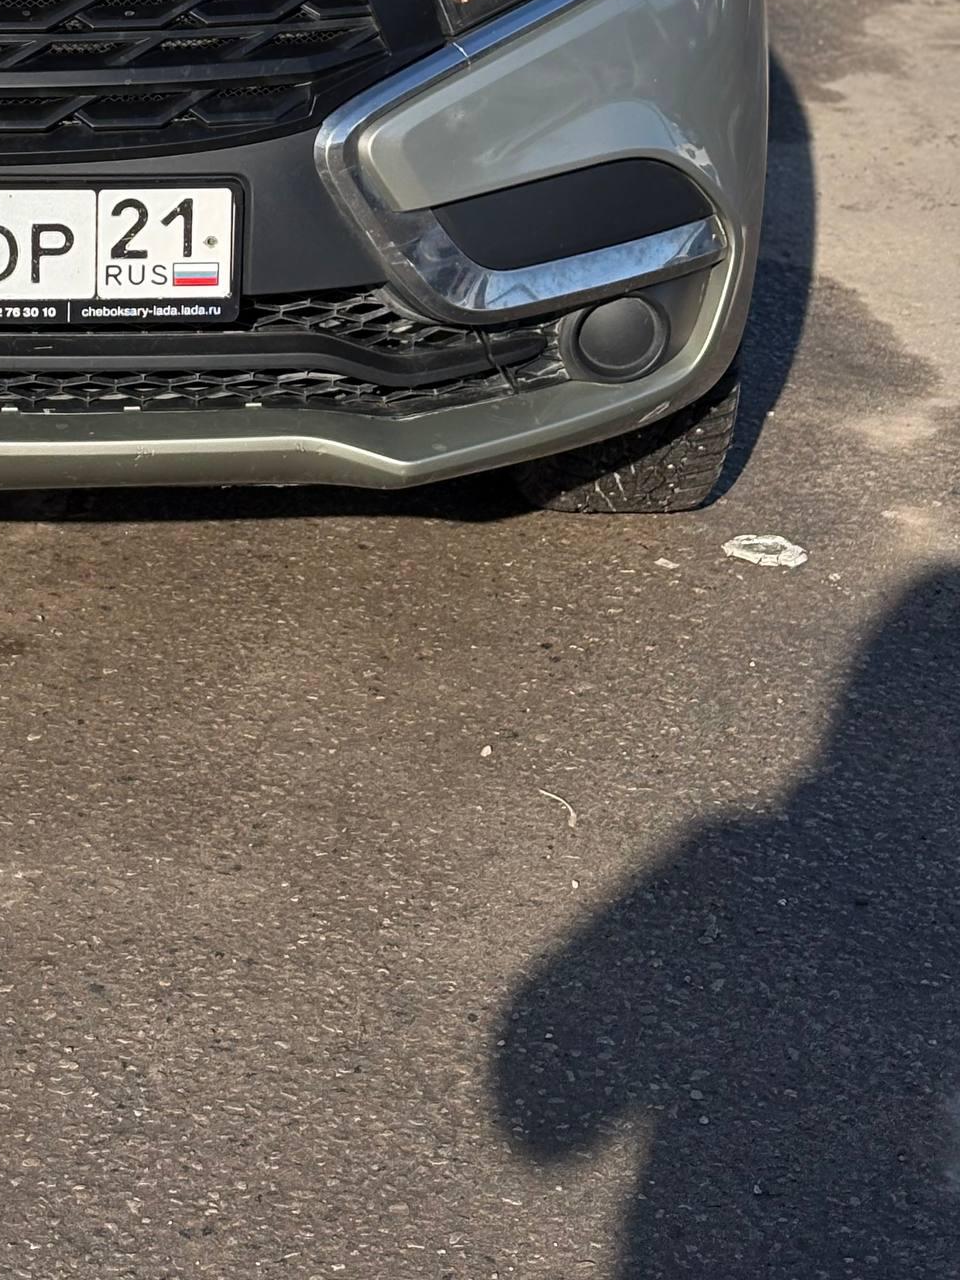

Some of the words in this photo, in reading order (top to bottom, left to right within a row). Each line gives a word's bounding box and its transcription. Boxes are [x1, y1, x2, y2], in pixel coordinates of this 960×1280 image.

[110, 198, 193, 259] 21
[105, 264, 168, 286] RUS
[5, 306, 21, 318] 76
[23, 306, 40, 318] 30
[42, 306, 57, 318] 10
[81, 305, 222, 319] cheboksary-lada.lada.ru
